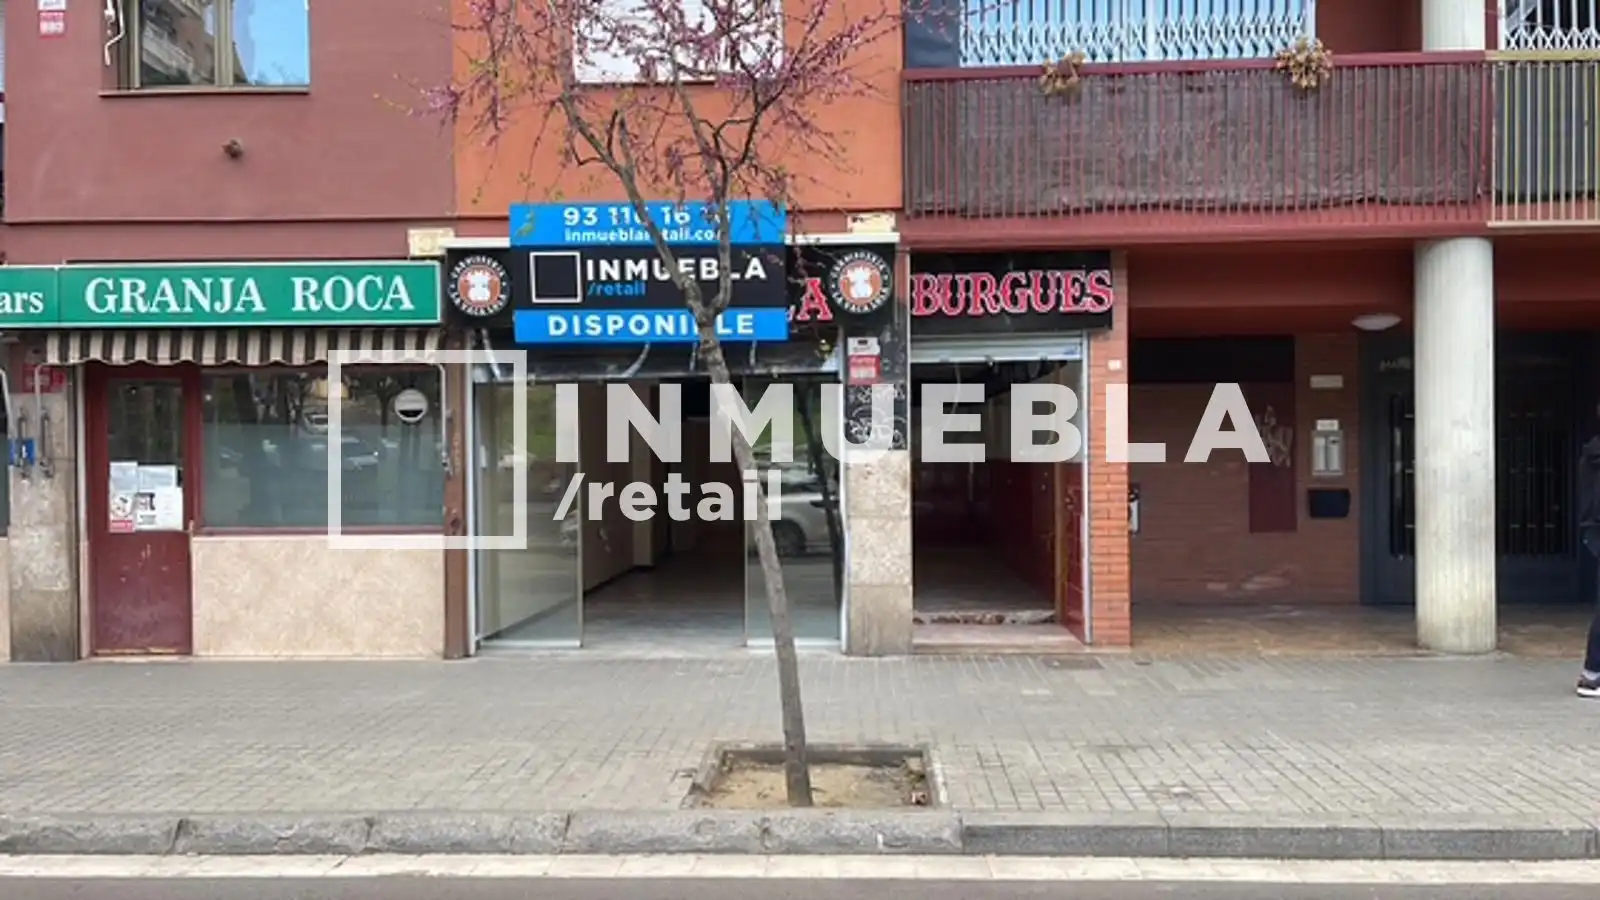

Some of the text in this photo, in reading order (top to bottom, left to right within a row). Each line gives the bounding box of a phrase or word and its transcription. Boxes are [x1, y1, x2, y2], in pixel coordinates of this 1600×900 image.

[563, 207, 597, 226] 93
[565, 227, 723, 242] inmueblartail.co
[586, 257, 767, 281] INMUEBA
[0, 291, 44, 314] ars
[85, 275, 414, 314] GRANJA ROCA
[911, 269, 1114, 316] BURGUES
[547, 313, 755, 337] DISPONILE
